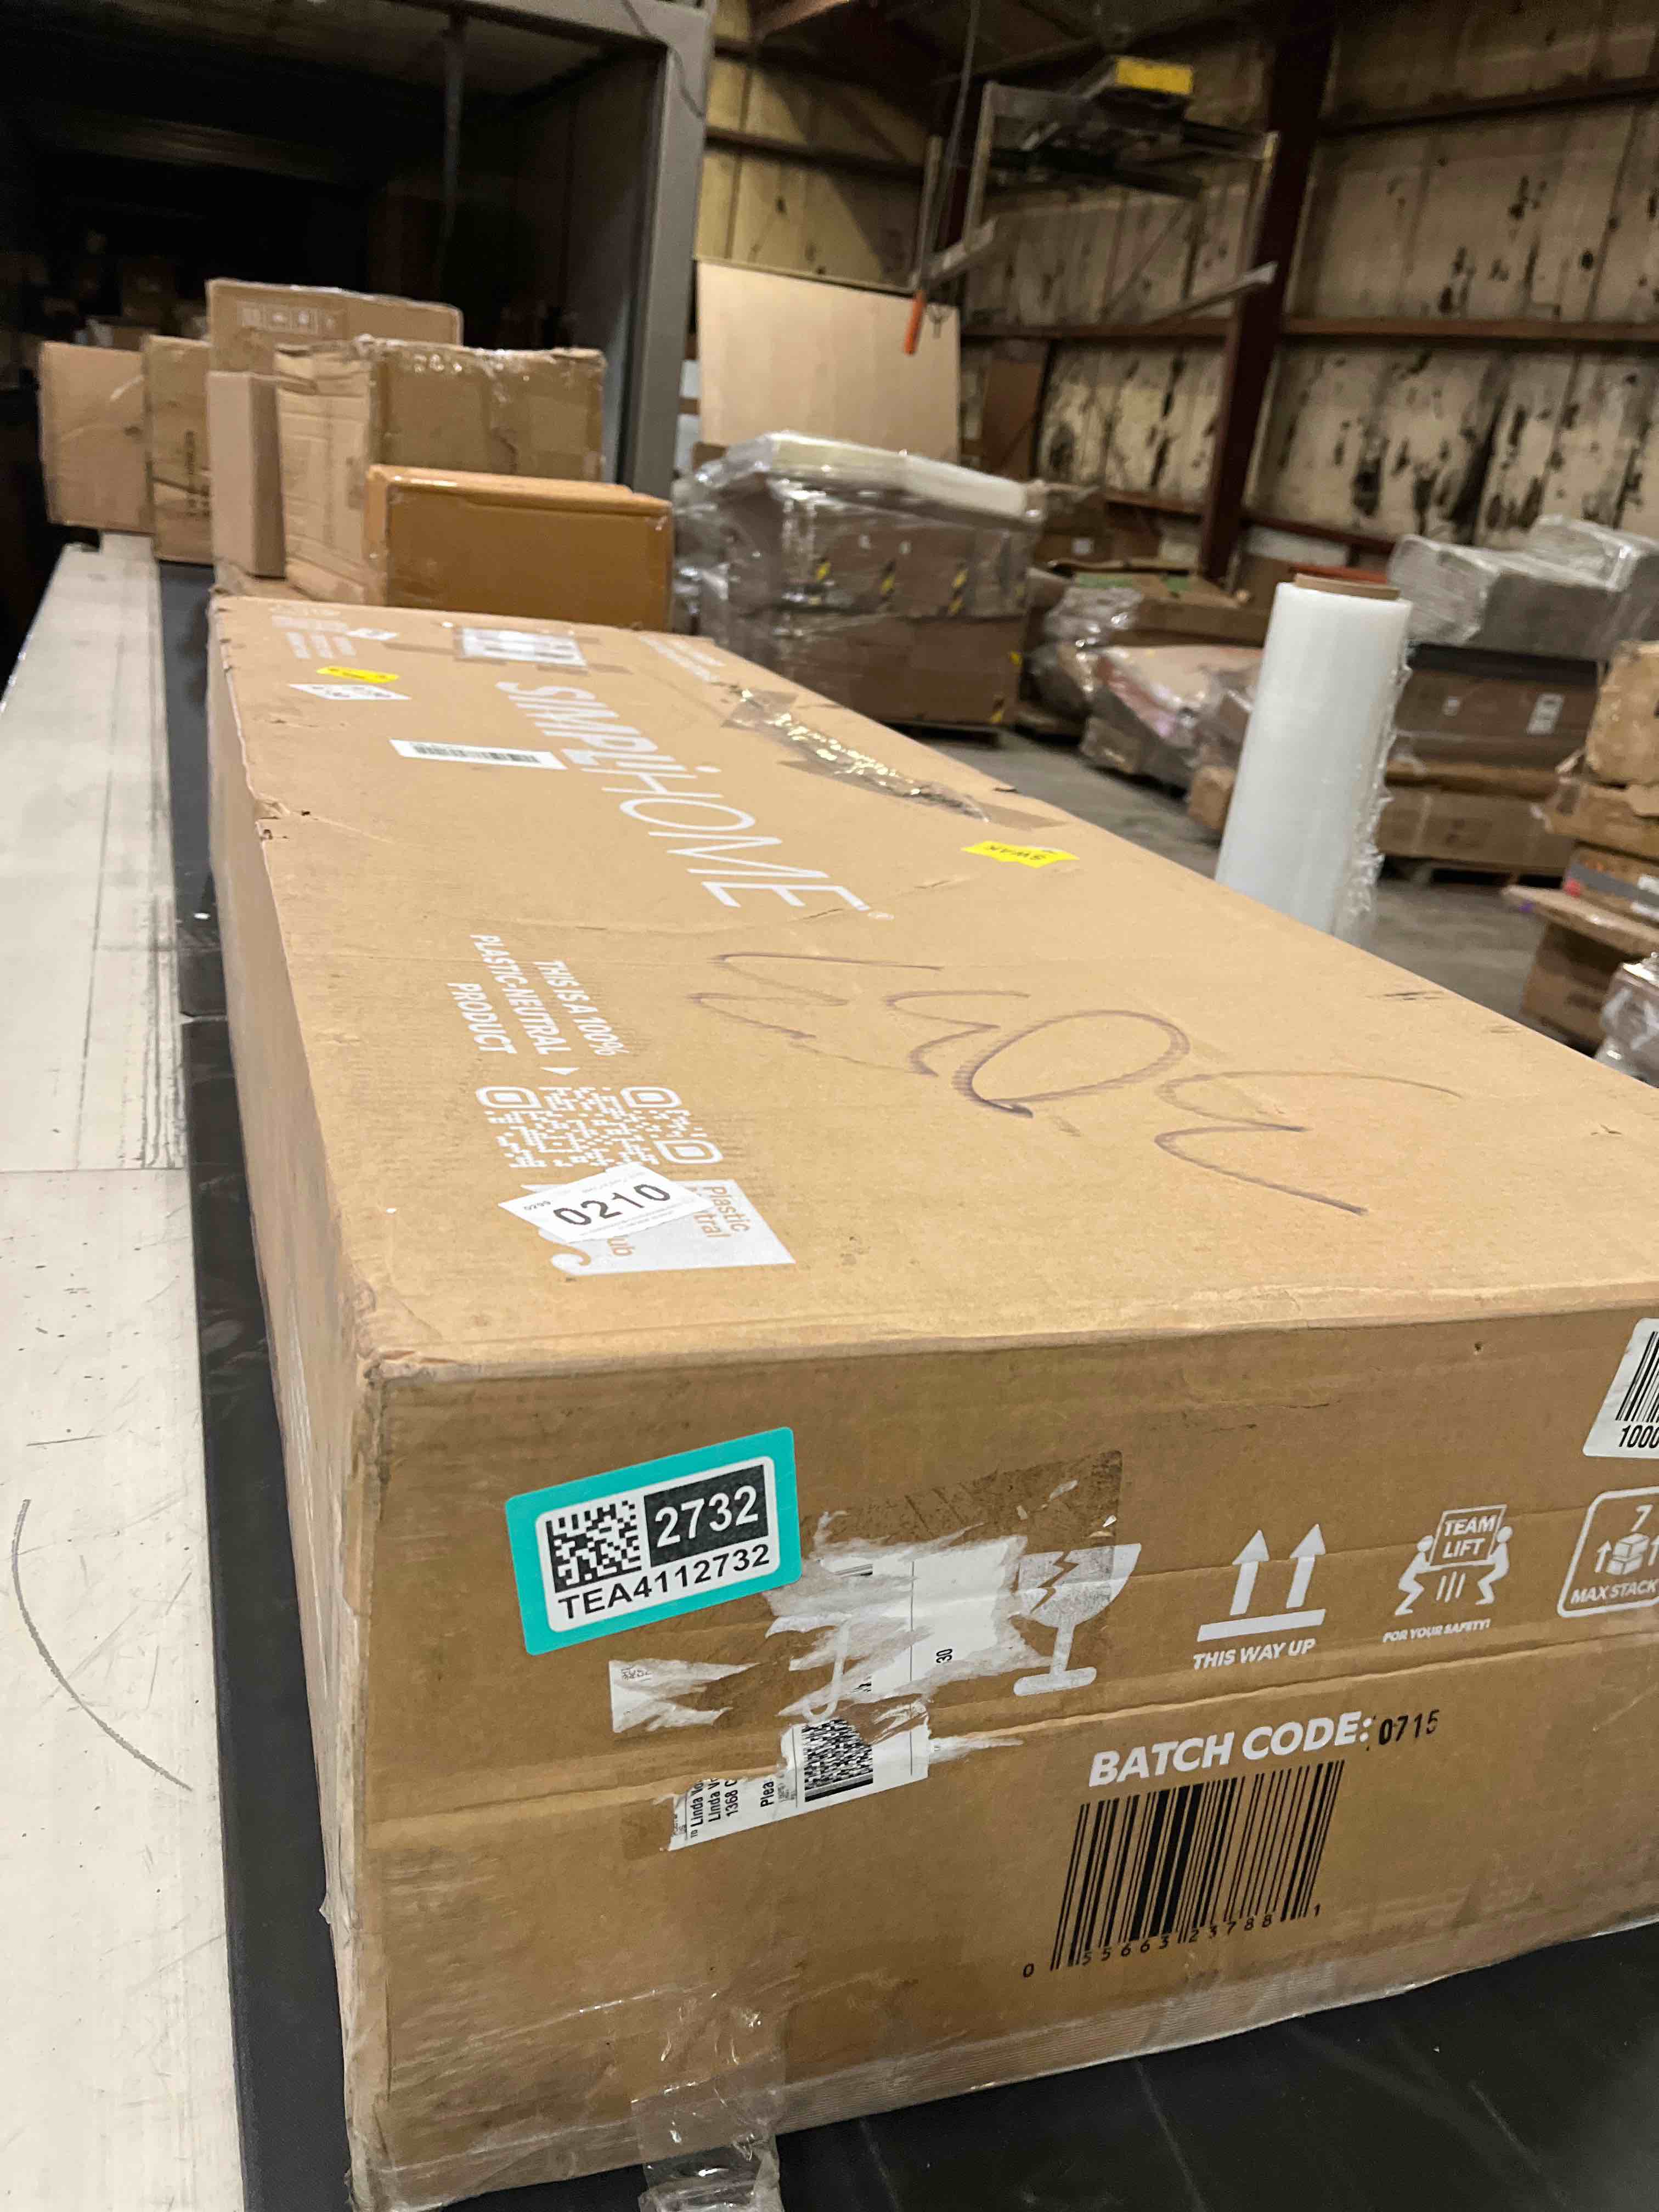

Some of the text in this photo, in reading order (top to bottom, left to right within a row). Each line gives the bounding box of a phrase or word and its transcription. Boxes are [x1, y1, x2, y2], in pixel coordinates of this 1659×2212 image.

[470, 934, 572, 1055] PLASTIC-NEUTRAL
[533, 961, 630, 1056] THIS IS A 100%
[446, 983, 518, 1054] PRODUCT
[553, 1183, 670, 1226] 0210
[703, 1186, 752, 1232] Plastic
[655, 1485, 758, 1548] 2732
[1444, 1515, 1497, 1536] TEAM
[1632, 1504, 1653, 1532] 7
[1442, 1538, 1486, 1559] LIFT
[558, 1544, 769, 1619] TEA4112732
[1571, 1579, 1659, 1604] MAX STACK
[1383, 1618, 1491, 1643] FOR YOUR SAFETY!
[936, 1649, 953, 1663] 30
[1193, 1638, 1316, 1670] THIS WAY UP
[1088, 1709, 1440, 1787] BATCH CODE: 0715
[690, 1797, 704, 1827] Linda
[708, 1791, 721, 1822] Linda
[725, 1790, 738, 1817] 1368
[1023, 1904, 1321, 1978] 0 55663 23788 1
